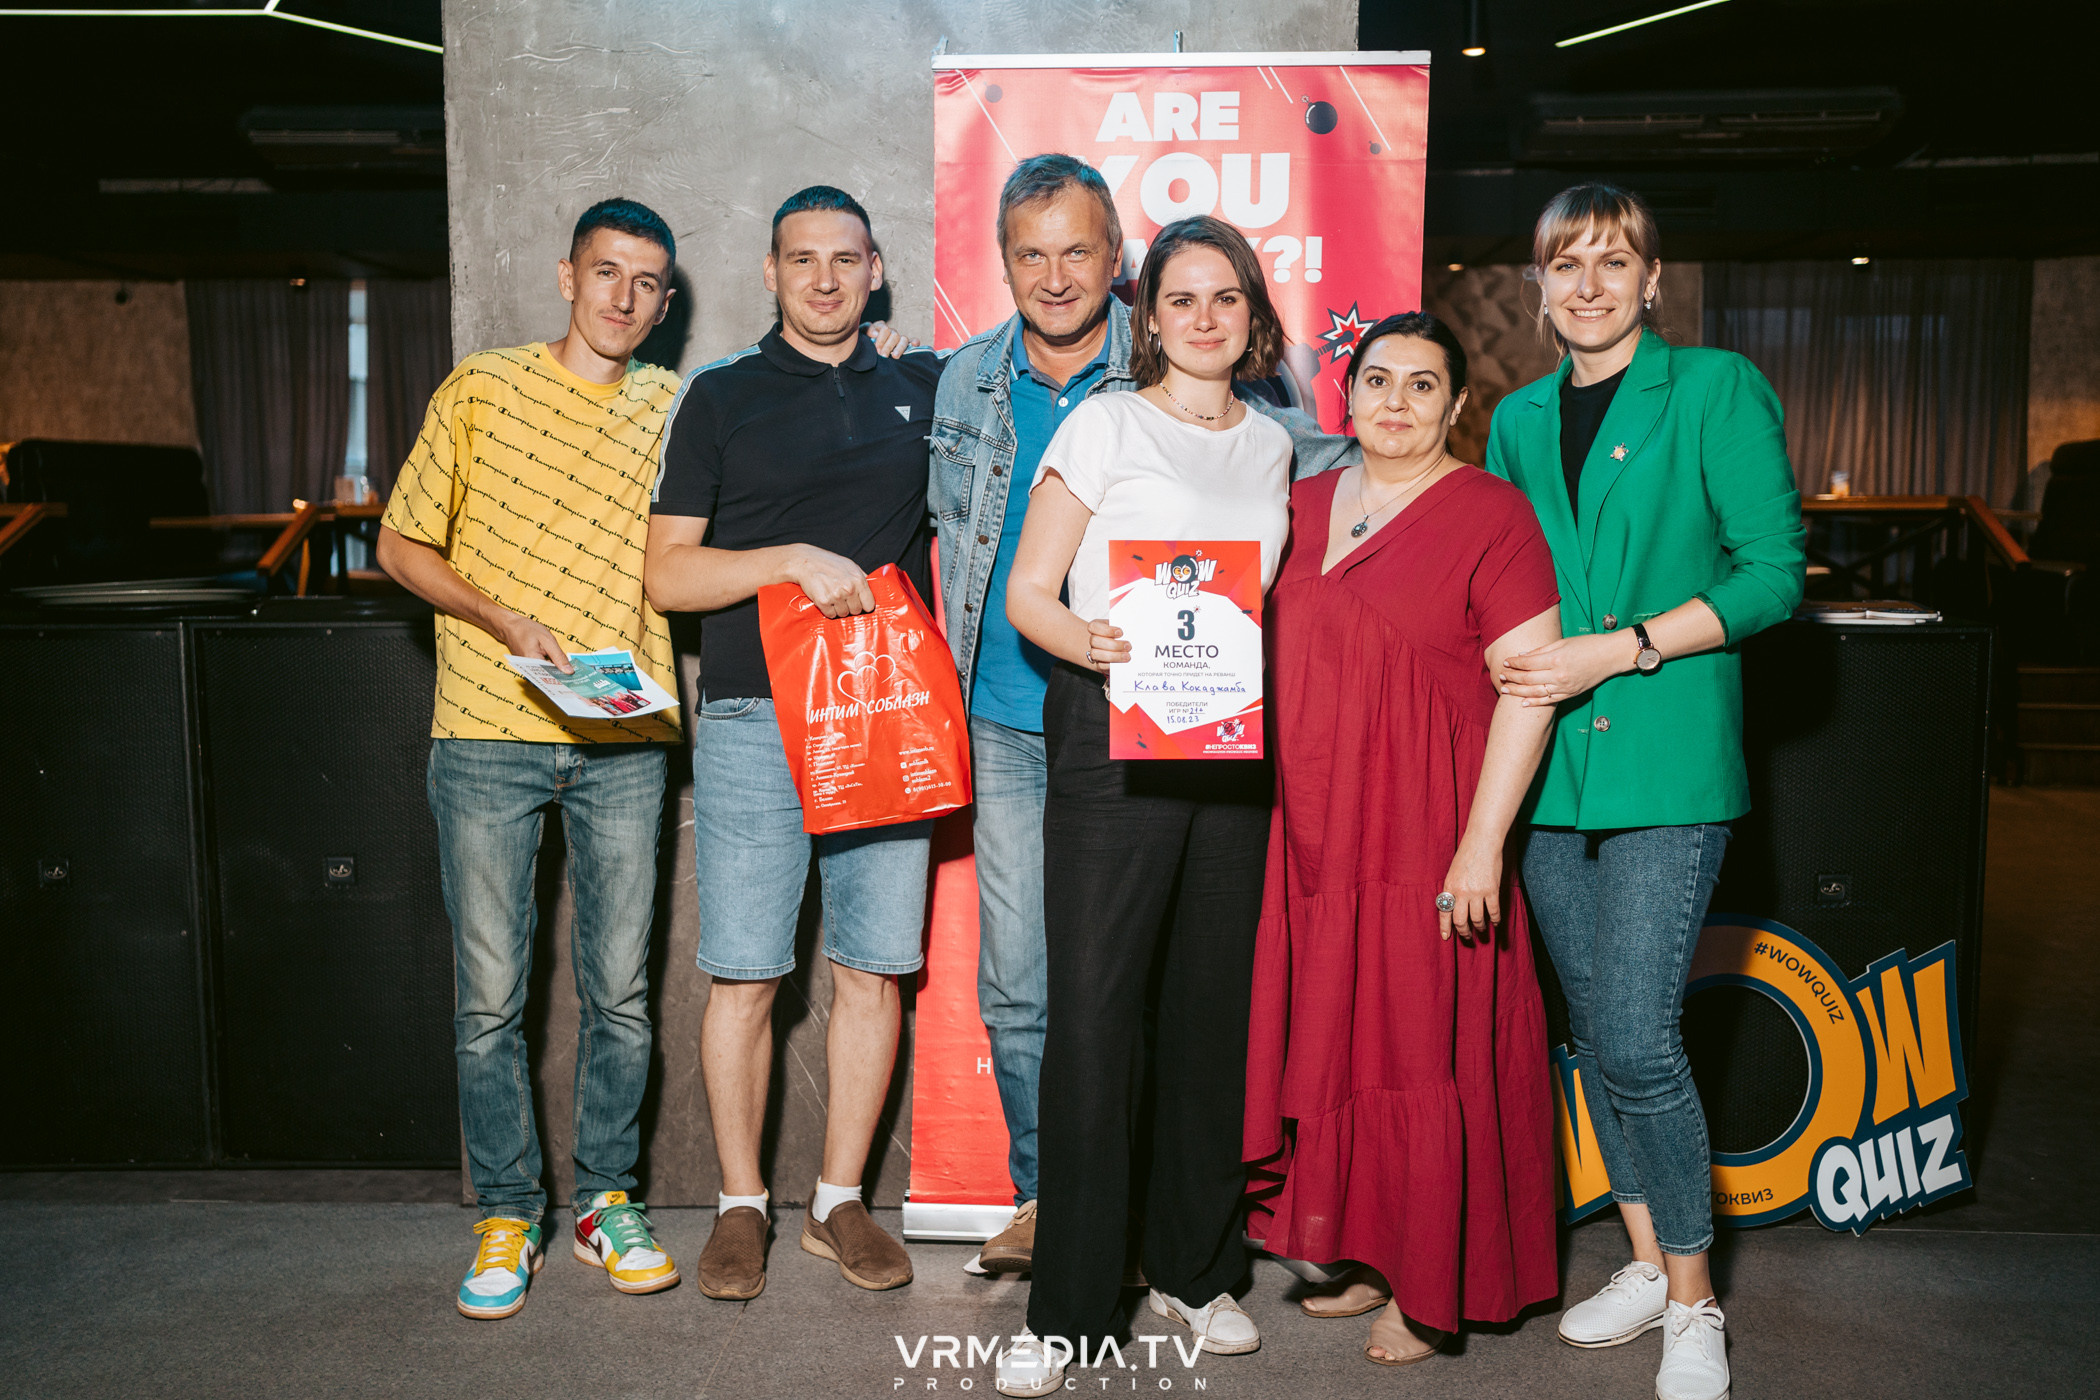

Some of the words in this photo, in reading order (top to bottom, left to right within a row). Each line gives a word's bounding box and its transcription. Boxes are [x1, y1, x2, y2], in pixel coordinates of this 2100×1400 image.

[1095, 91, 1240, 142] ARE
[467, 368, 509, 384] Champion
[512, 384, 551, 408] Champion
[553, 408, 593, 428] Champion
[595, 427, 629, 447] Champion
[522, 365, 565, 387] Champion
[567, 386, 604, 409] Champion
[498, 407, 538, 430] Champion
[540, 430, 580, 450] Champion
[582, 450, 616, 471] Champion
[486, 431, 523, 453] Champion
[526, 452, 565, 474] Champion
[567, 473, 602, 495] Champion
[473, 456, 509, 477] Champion
[511, 476, 550, 499] Champion
[553, 498, 587, 520] Champion
[589, 518, 623, 539] Champion
[499, 501, 534, 523] Champion
[536, 522, 572, 543] Champion
[575, 542, 610, 563] Champion
[487, 525, 519, 548] Champion
[521, 546, 557, 567] Champion
[559, 566, 597, 588] Champion
[597, 586, 630, 607] Champion
[475, 549, 505, 571] Champion
[506, 570, 541, 591] Champion
[543, 590, 581, 611] Champion
[583, 610, 617, 632] Champion
[1166, 580, 1199, 600] QUIZ
[1177, 610, 1195, 640] 3
[460, 639, 492, 661] Champion
[1155, 645, 1219, 658] МЕСТО
[1163, 661, 1210, 669] КОМАНДА,
[476, 683, 514, 705] Champion
[516, 704, 557, 726] Champion
[809, 702, 860, 724] ИНТИМ
[866, 690, 930, 714] СОБЛАЗН
[1134, 680, 1175, 691] Клава
[460, 707, 498, 728] Champion
[1754, 942, 1844, 1024] #WOWQUIZ
[1816, 1114, 1962, 1223] QUIZ
